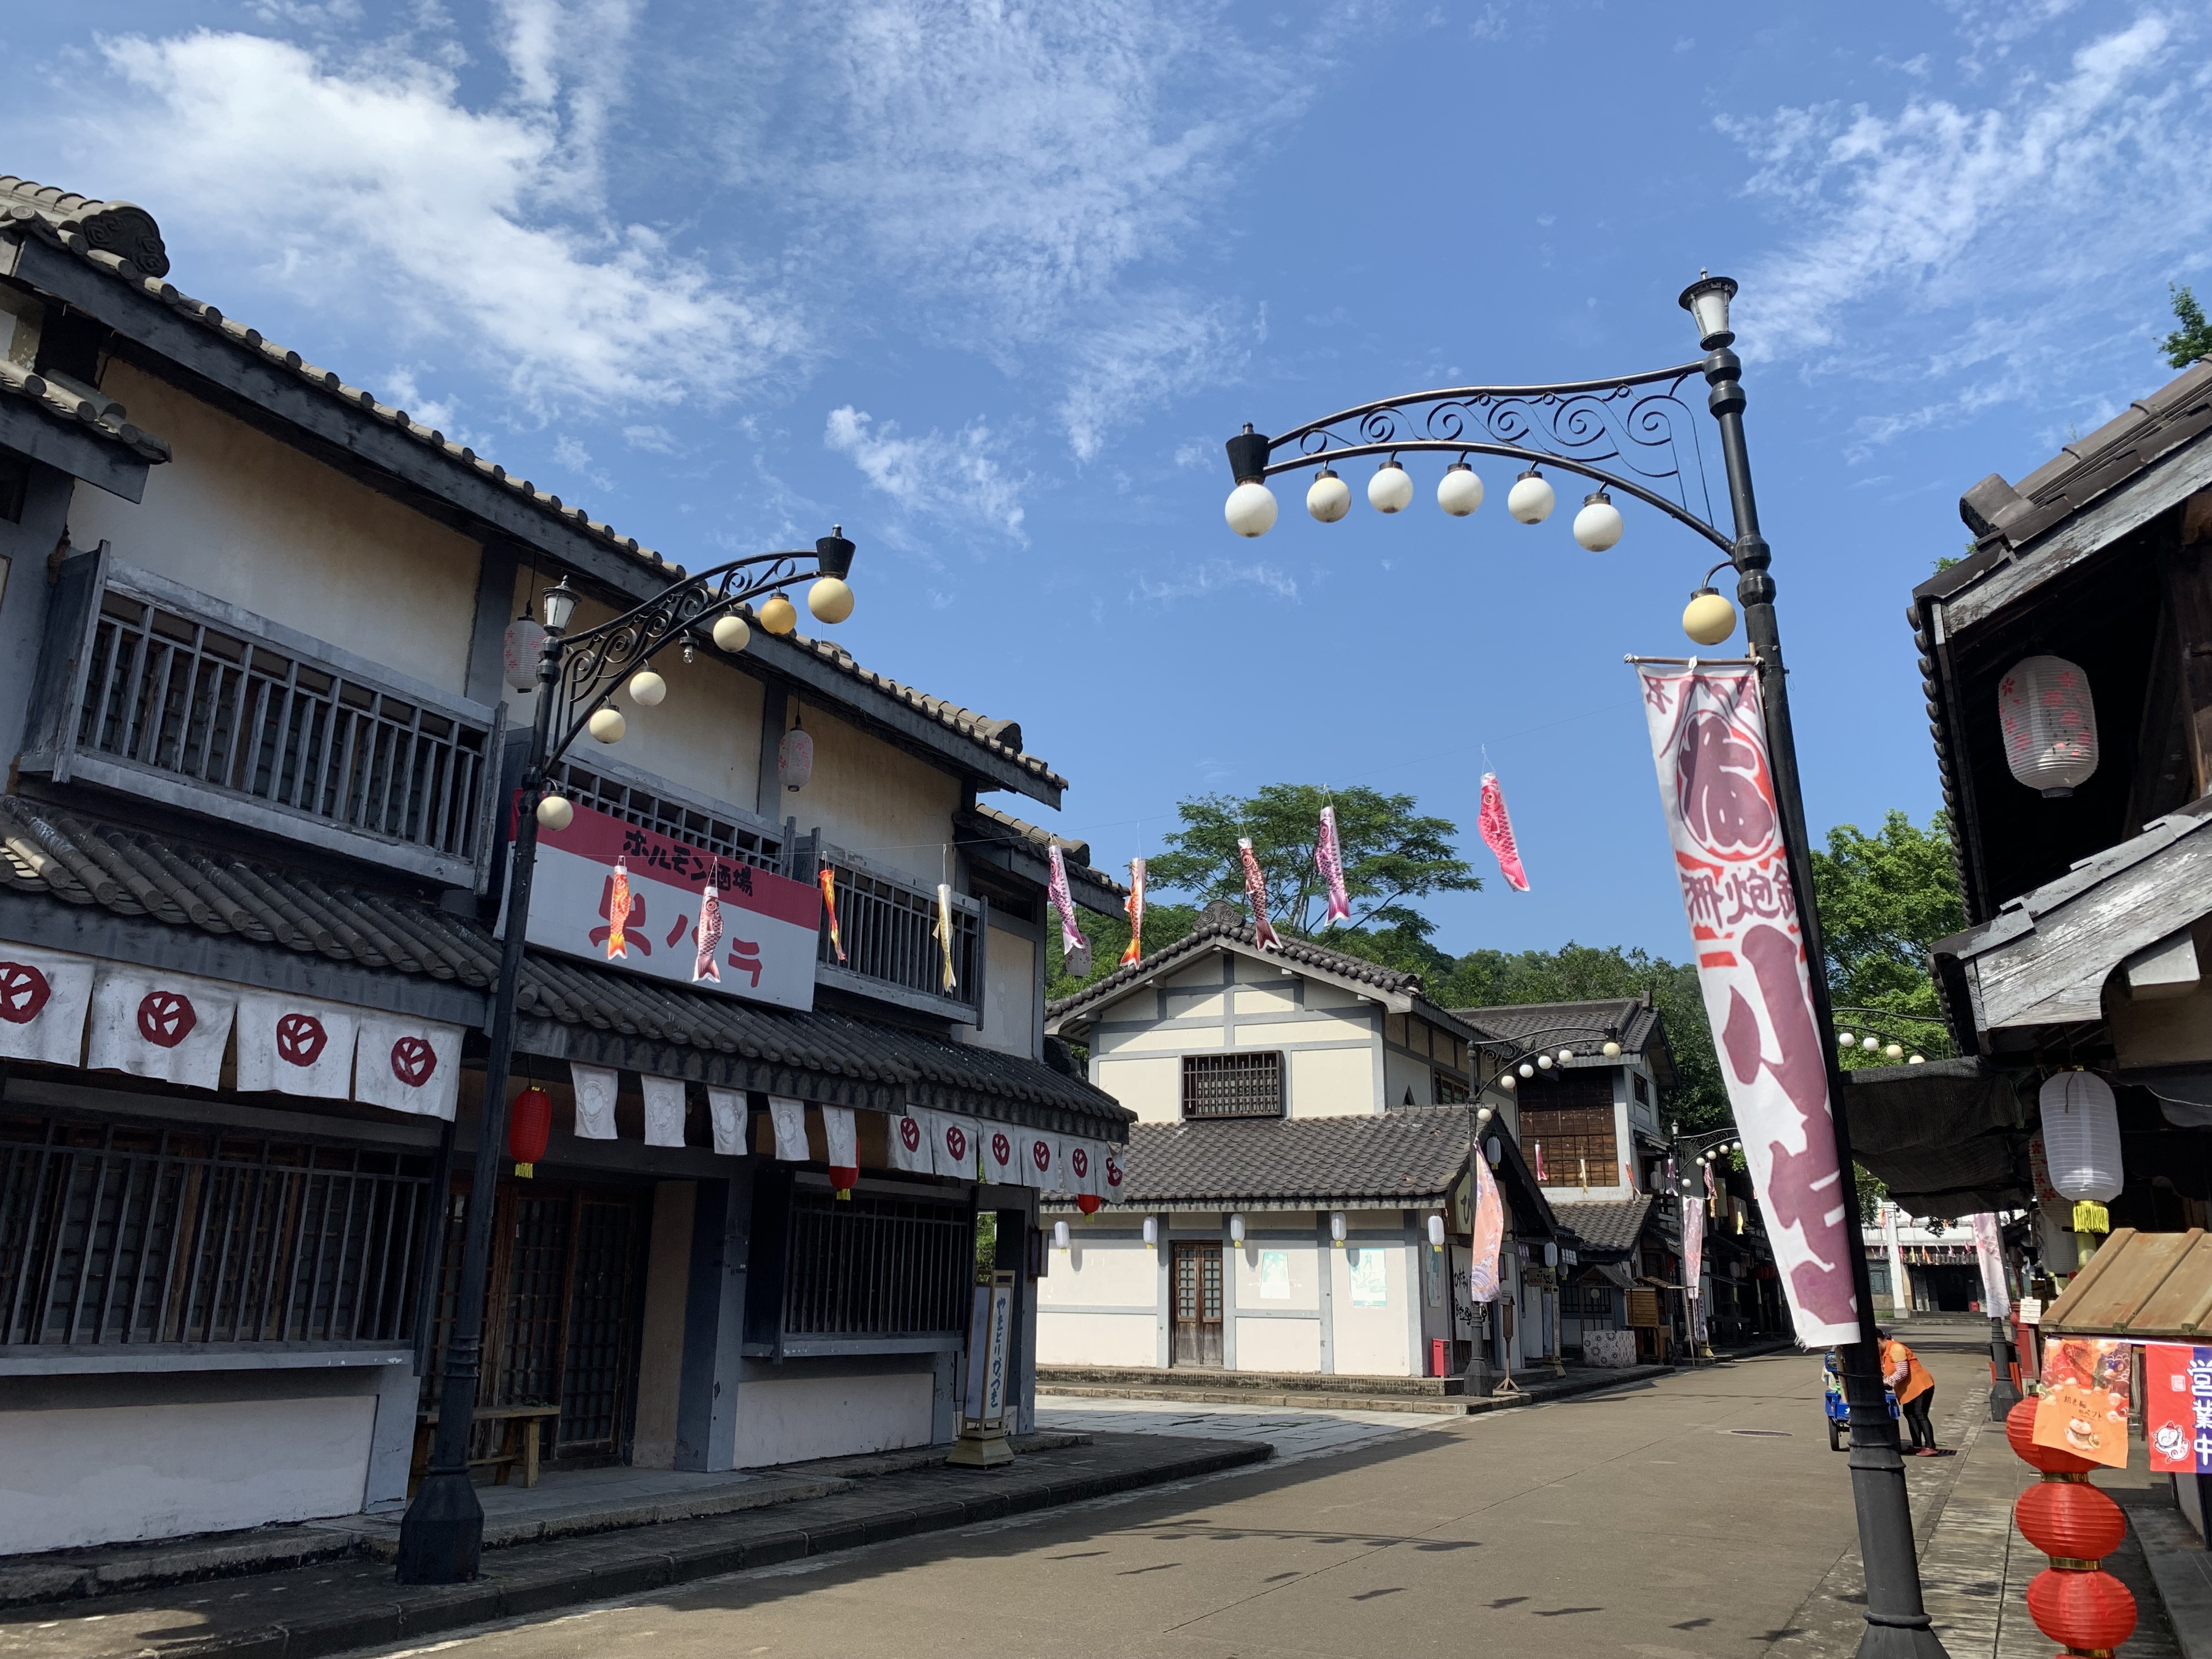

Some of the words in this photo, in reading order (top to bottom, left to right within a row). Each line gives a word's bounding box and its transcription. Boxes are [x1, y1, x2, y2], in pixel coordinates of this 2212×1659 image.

[623, 830, 753, 897] ホルモン酒場
